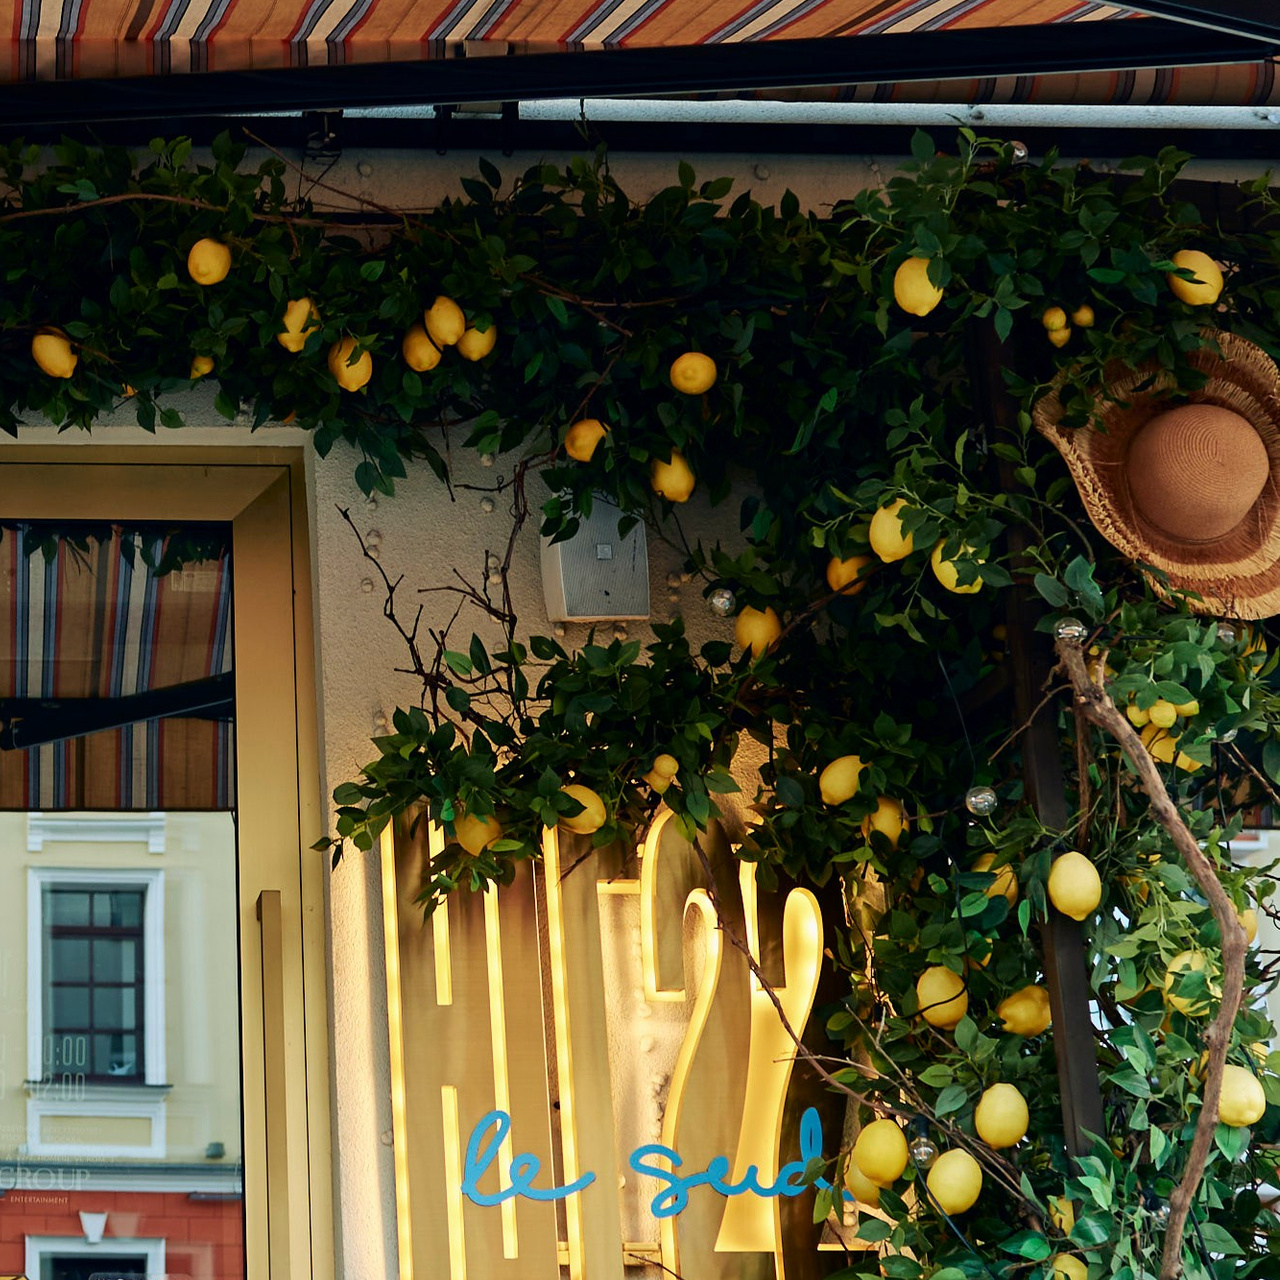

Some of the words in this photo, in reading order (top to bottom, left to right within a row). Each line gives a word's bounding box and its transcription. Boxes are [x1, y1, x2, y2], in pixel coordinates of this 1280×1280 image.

[31, 1035, 86, 1067] 0:00
[461, 1109, 596, 1206] le
[629, 1105, 856, 1219] sud
[10, 1195, 68, 1205] ENTERTAINMENT
